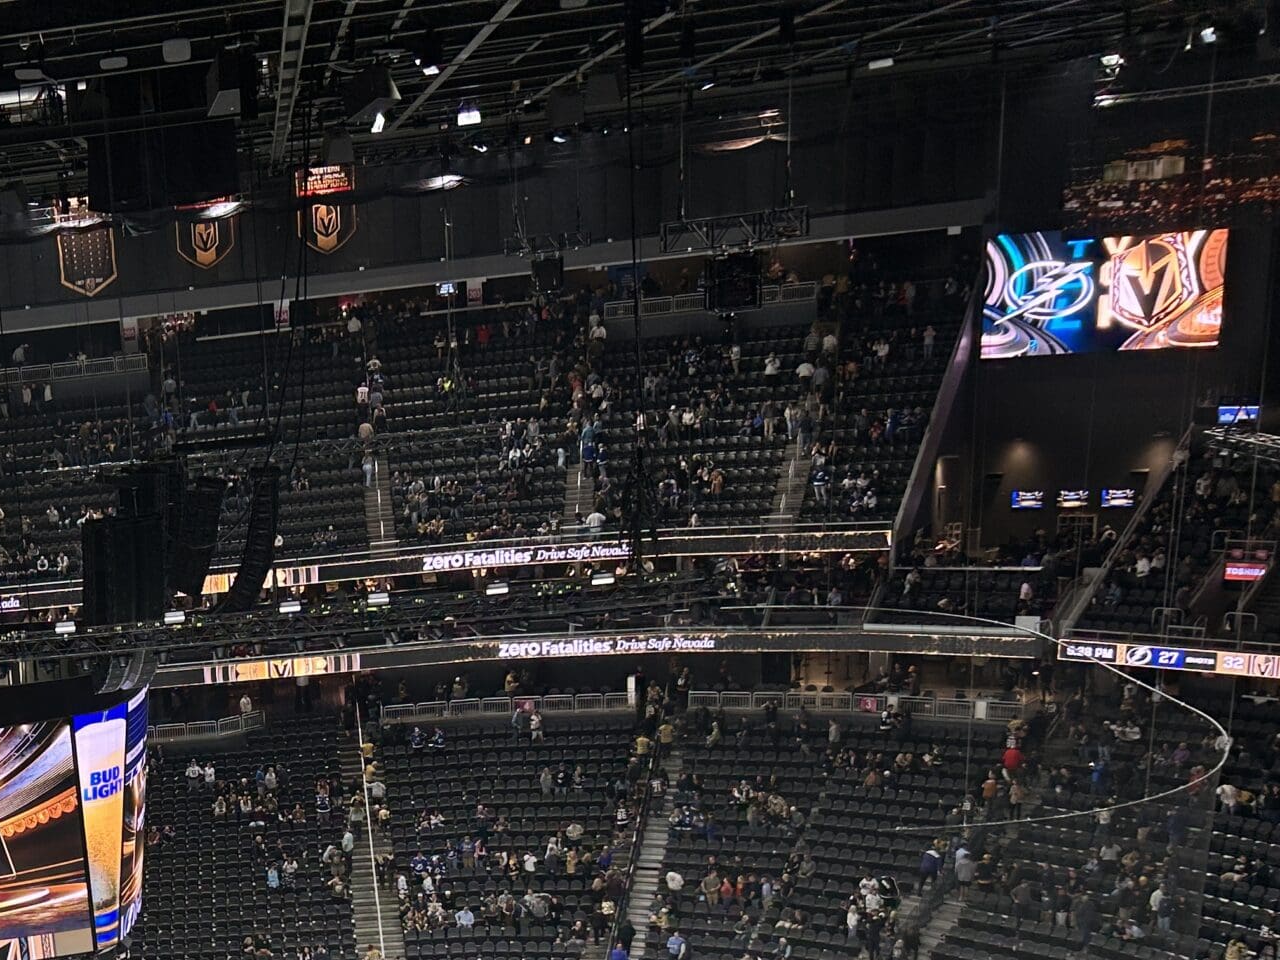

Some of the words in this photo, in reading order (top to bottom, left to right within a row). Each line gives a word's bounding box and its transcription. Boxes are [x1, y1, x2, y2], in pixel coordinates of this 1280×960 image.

[423, 553, 465, 571] zero
[465, 547, 533, 566] Fatalities
[536, 547, 565, 560] Drive
[566, 546, 590, 558] Safe
[499, 642, 540, 658] zero
[542, 640, 612, 657] Fatalities
[616, 639, 646, 651] Drive
[648, 638, 670, 650] Safe
[672, 637, 715, 650] Nevada
[1095, 649, 1114, 659] PM
[1158, 651, 1180, 665] 27
[1223, 656, 1244, 669] 32
[90, 766, 120, 786] BUD
[83, 777, 123, 801] LIGHT
